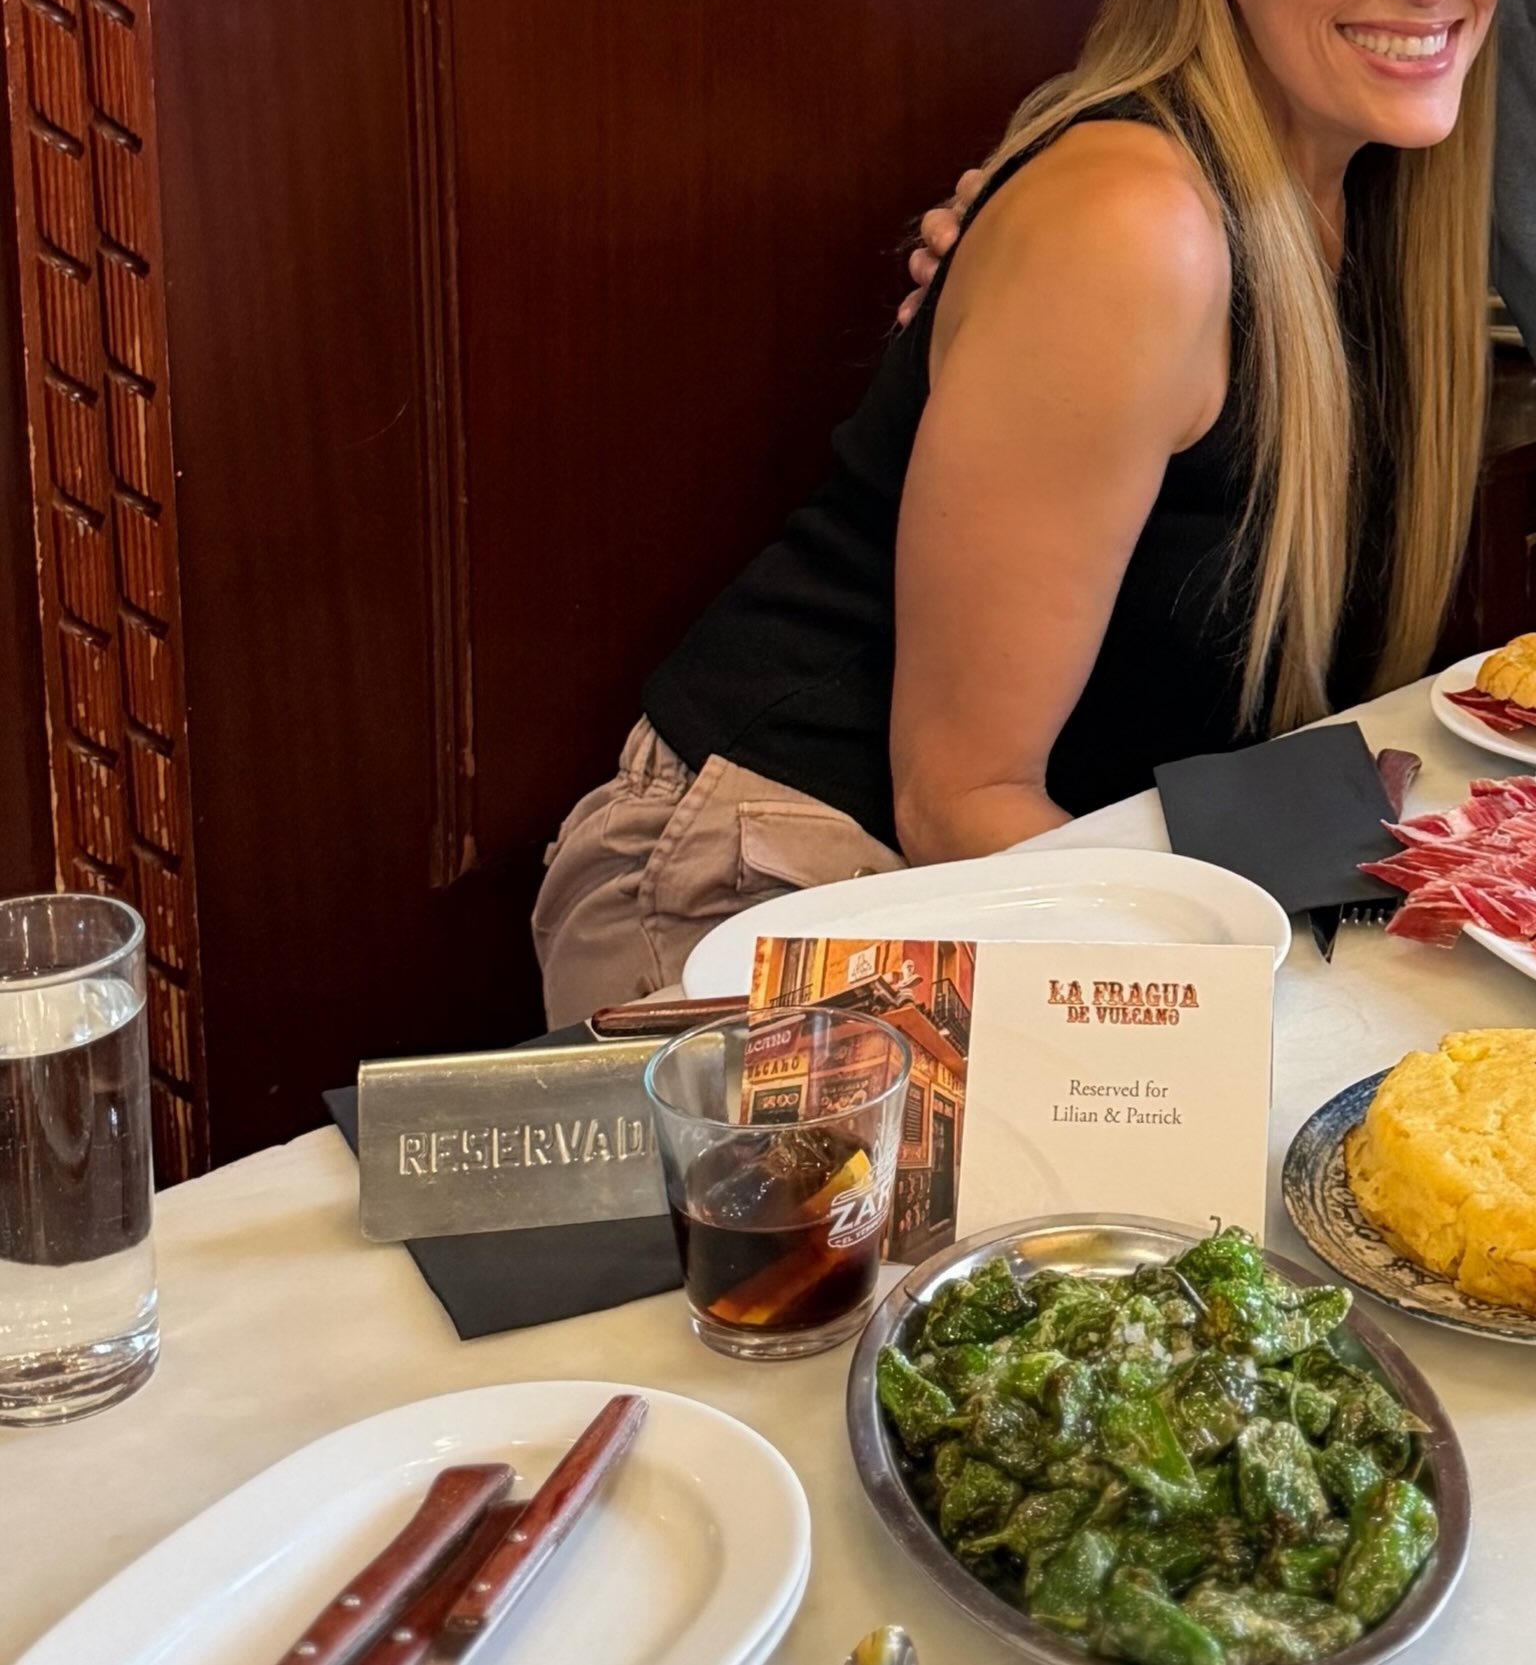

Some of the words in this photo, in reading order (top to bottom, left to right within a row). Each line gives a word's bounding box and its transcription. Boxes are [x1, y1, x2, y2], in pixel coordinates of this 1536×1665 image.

[1047, 979, 1085, 1005] LA
[1092, 981, 1200, 1008] FRAGUA
[1066, 1006, 1090, 1024] DE
[1096, 1006, 1181, 1026] VULCANO
[1069, 1079, 1140, 1098] Reserved
[1145, 1080, 1169, 1098] for
[1053, 1105, 1098, 1124] Lilian
[1104, 1107, 1121, 1124] &
[1126, 1107, 1183, 1125] Patrick
[399, 1116, 657, 1176] RESERVAD
